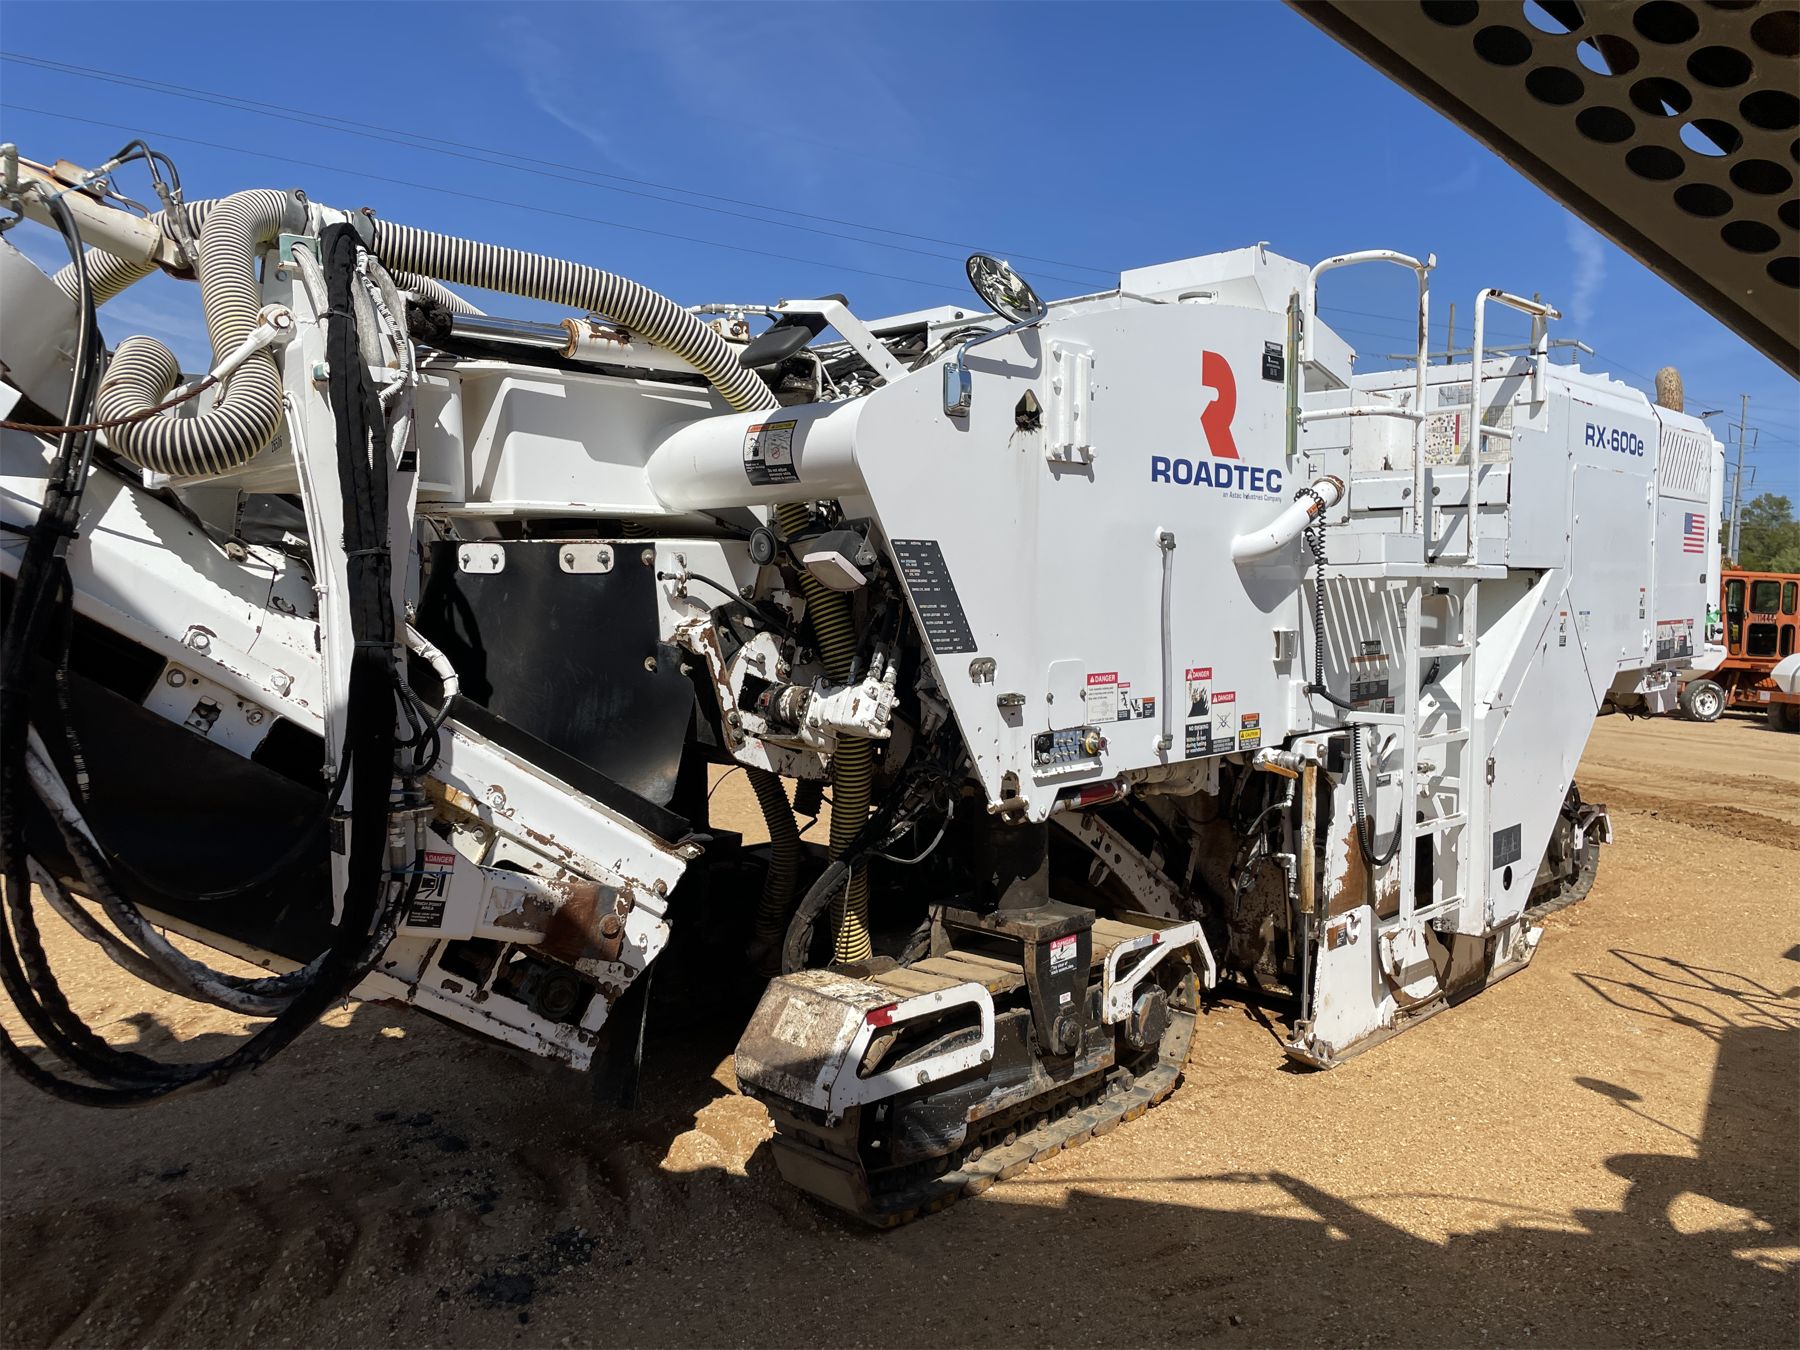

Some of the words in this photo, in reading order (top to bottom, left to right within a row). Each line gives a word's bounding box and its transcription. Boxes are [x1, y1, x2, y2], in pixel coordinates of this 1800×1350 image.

[1151, 455, 1282, 494] ROADTEC
[1229, 491, 1242, 499] Astec
[1242, 492, 1263, 501] Industries
[1263, 494, 1282, 503] Company
[1094, 674, 1116, 683] DANGER
[1193, 670, 1210, 678] DANGER
[1217, 693, 1234, 702] DANGER
[427, 855, 453, 864] DANGER
